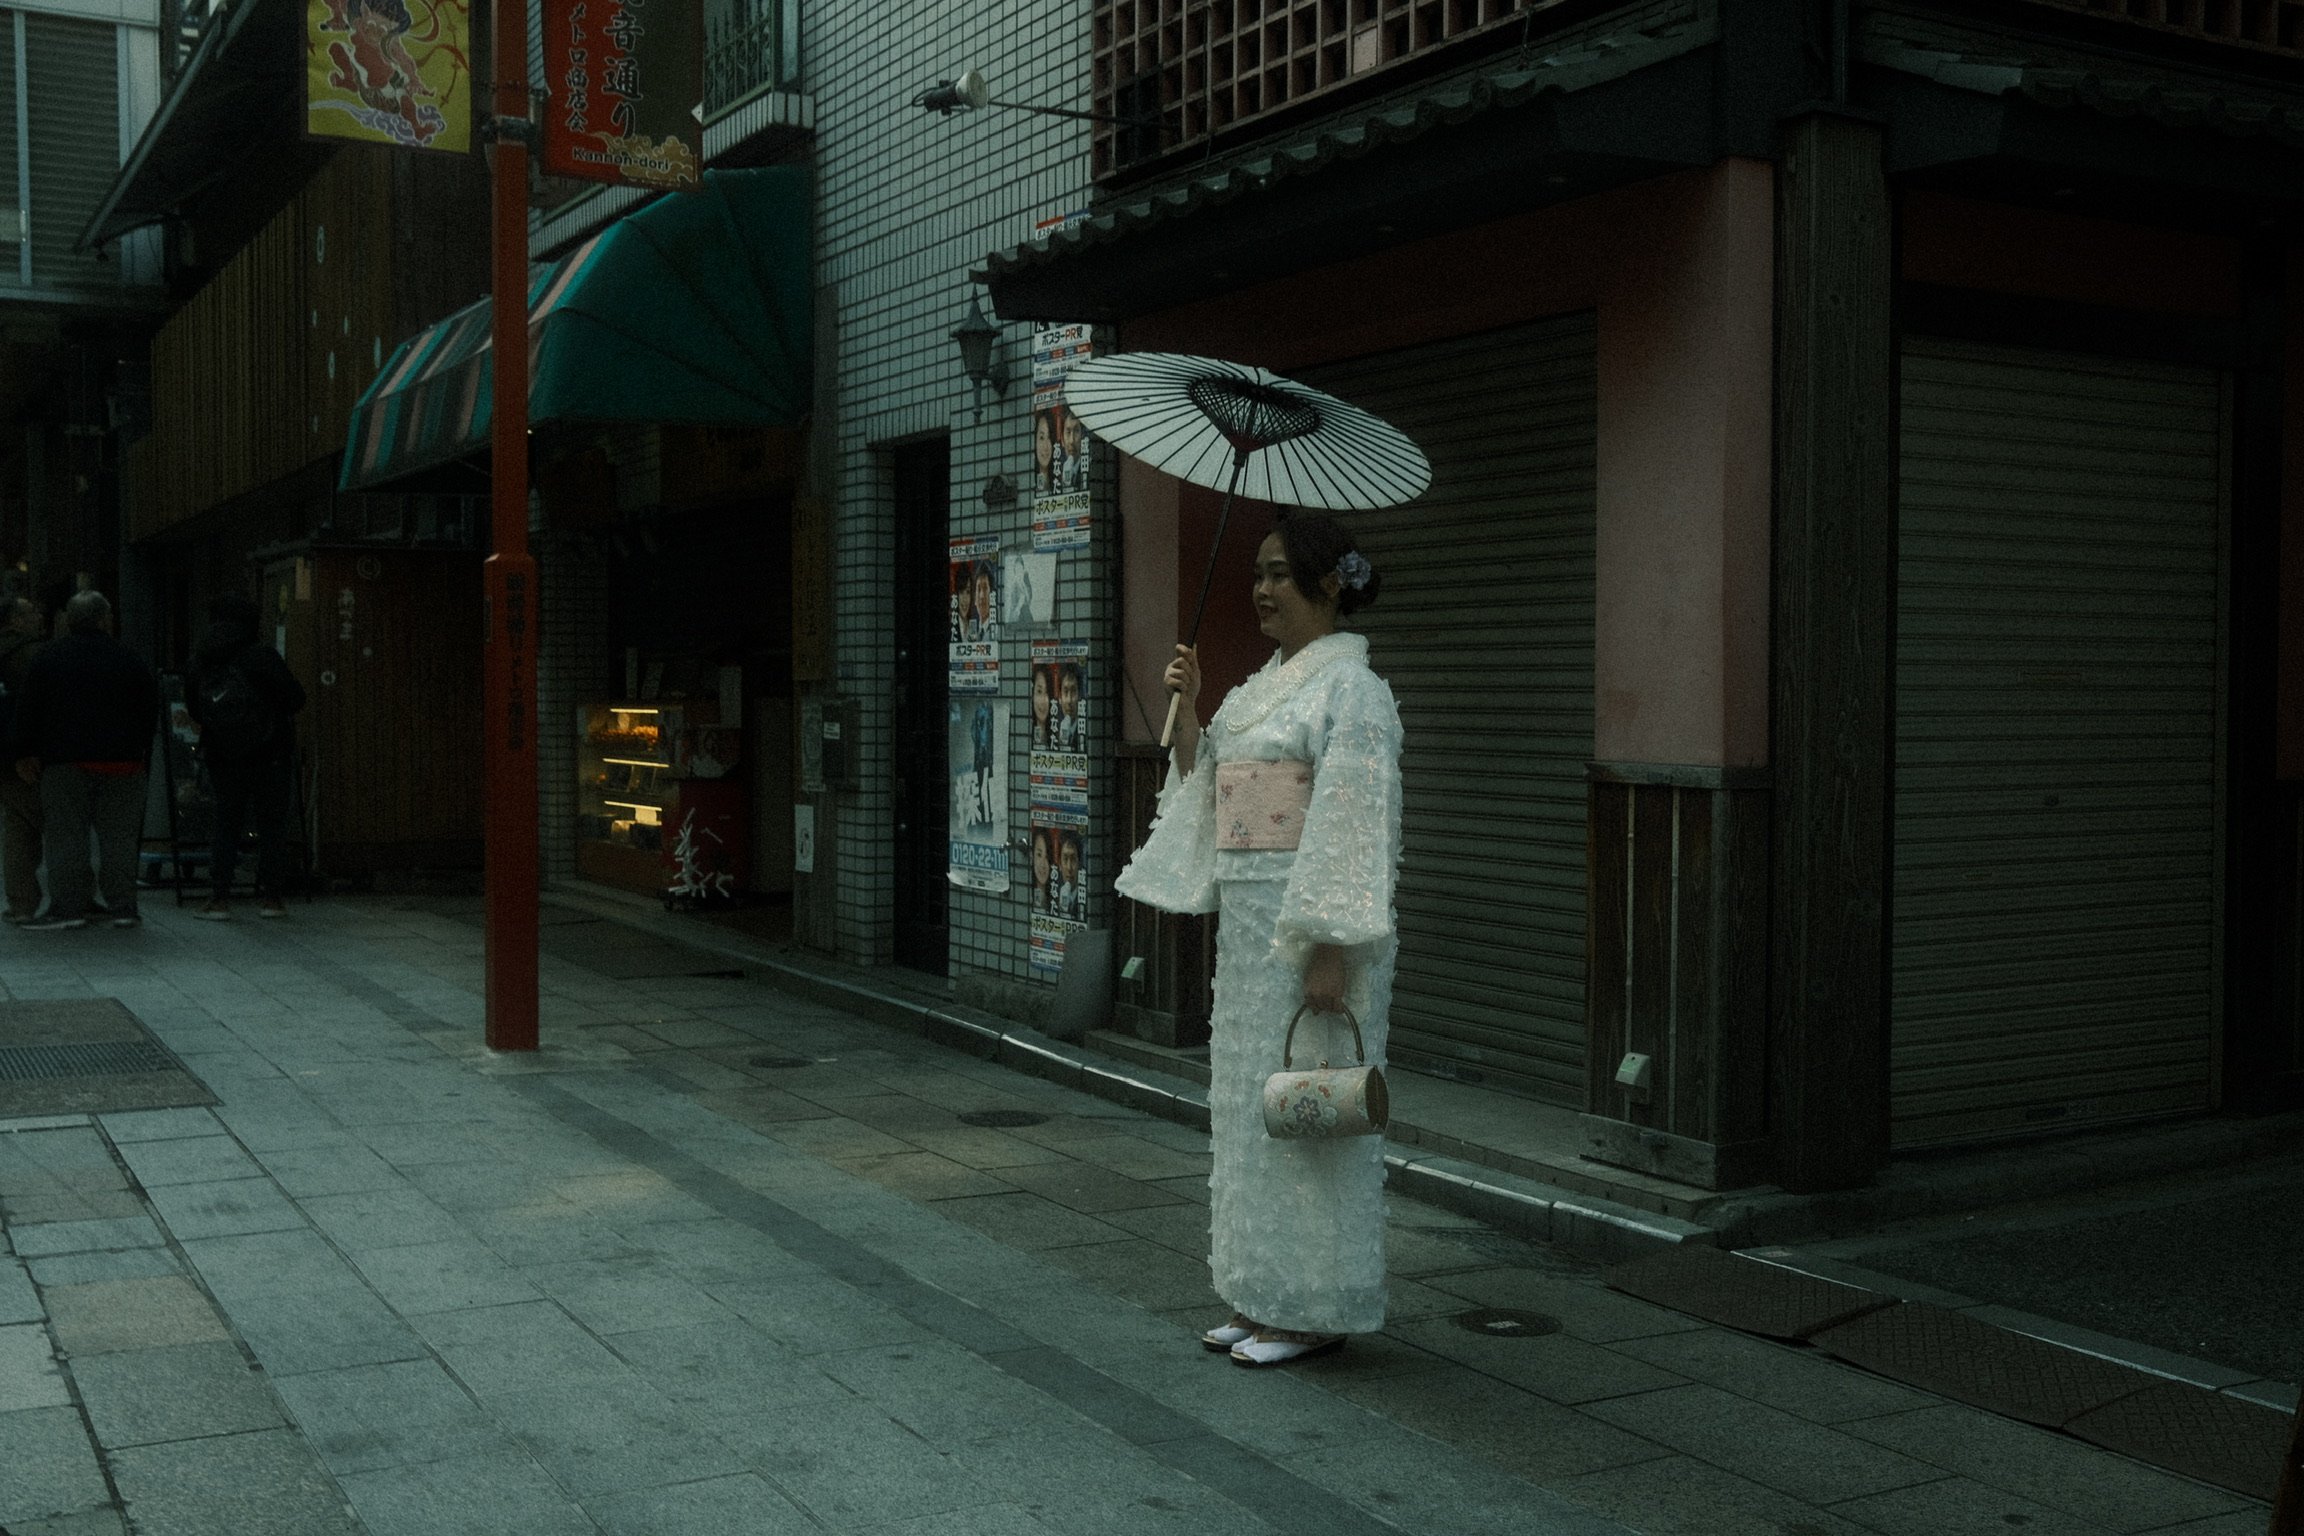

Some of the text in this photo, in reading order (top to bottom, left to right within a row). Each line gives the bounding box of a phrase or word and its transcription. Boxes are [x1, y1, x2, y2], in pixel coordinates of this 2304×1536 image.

[566, 3, 589, 134] メトロ商店会
[602, 0, 646, 139] 音通り
[573, 148, 670, 171] Kannon-dori
[1052, 442, 1062, 494] あなた
[950, 594, 959, 642] あなた
[1050, 698, 1059, 751] あなた
[1050, 863, 1059, 916] あなた
